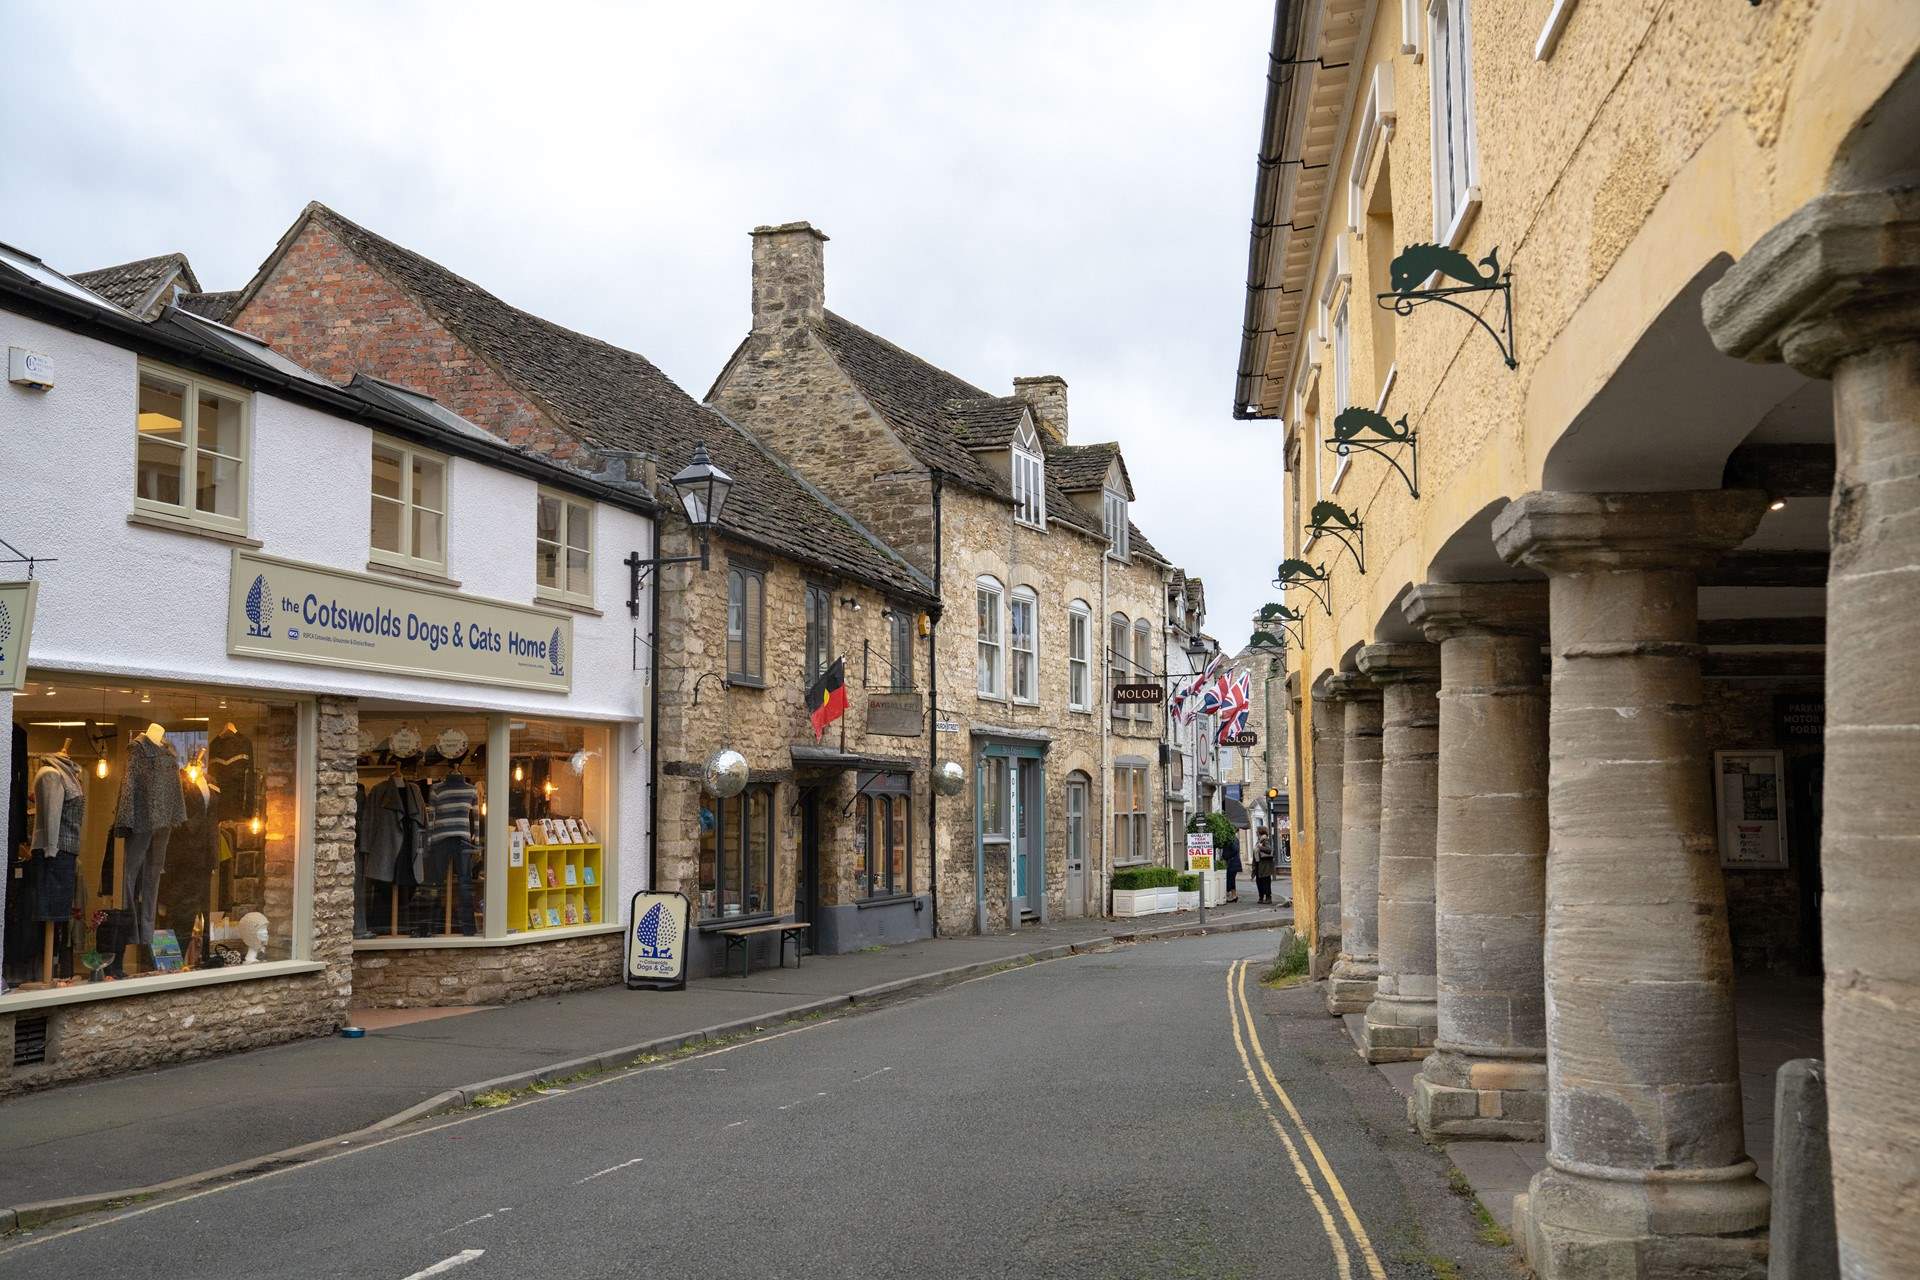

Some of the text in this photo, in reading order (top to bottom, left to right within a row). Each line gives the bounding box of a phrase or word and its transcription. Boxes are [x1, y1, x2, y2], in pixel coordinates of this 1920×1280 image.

[282, 593, 546, 659] the Cotswolds Dogs & Cats Home
[1117, 689, 1159, 699] MOLOH
[1789, 703, 1824, 713] PARKIN
[1226, 735, 1255, 743] OLOH
[637, 963, 652, 971] Dogs
